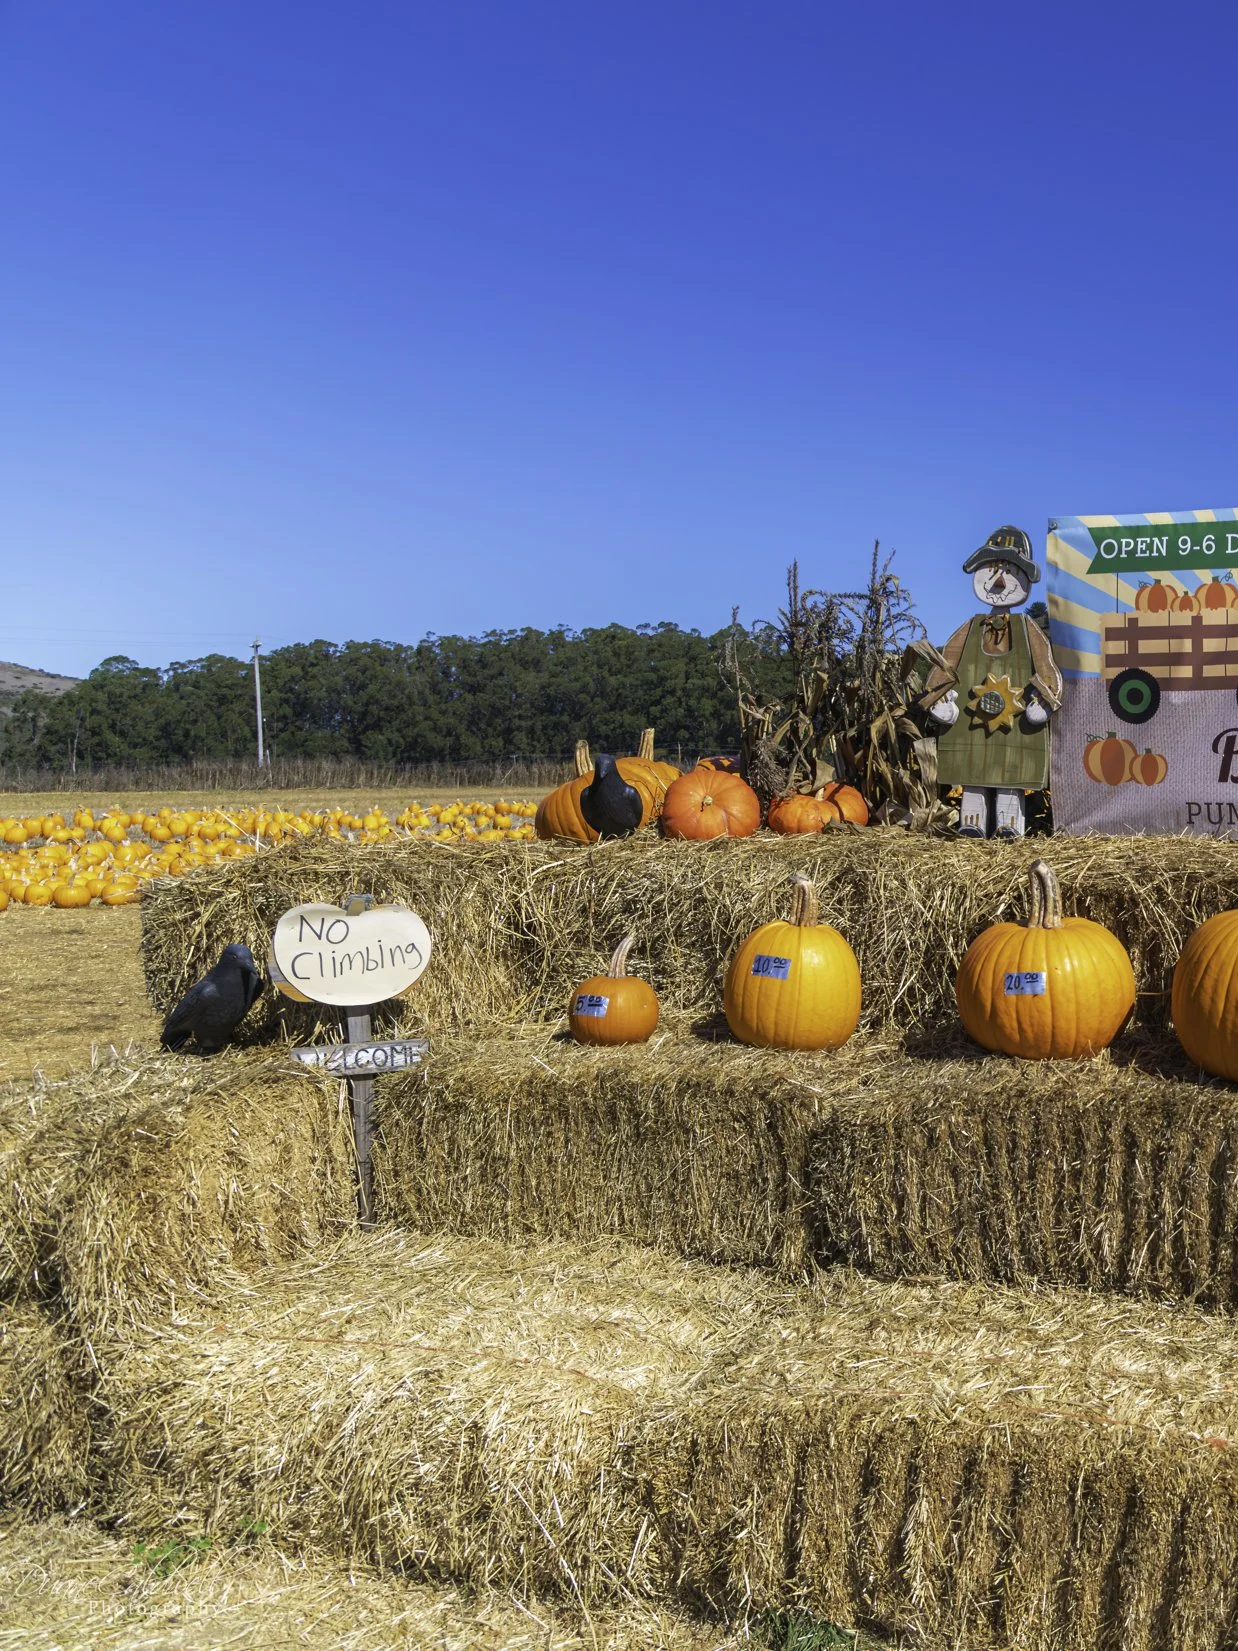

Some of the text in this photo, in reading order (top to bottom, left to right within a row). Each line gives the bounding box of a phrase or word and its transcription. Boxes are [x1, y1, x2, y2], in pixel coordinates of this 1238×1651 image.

[1099, 537, 1170, 559] OPEN
[1178, 534, 1217, 556] 9-6
[298, 915, 350, 945] NO
[291, 939, 423, 980] Climbing
